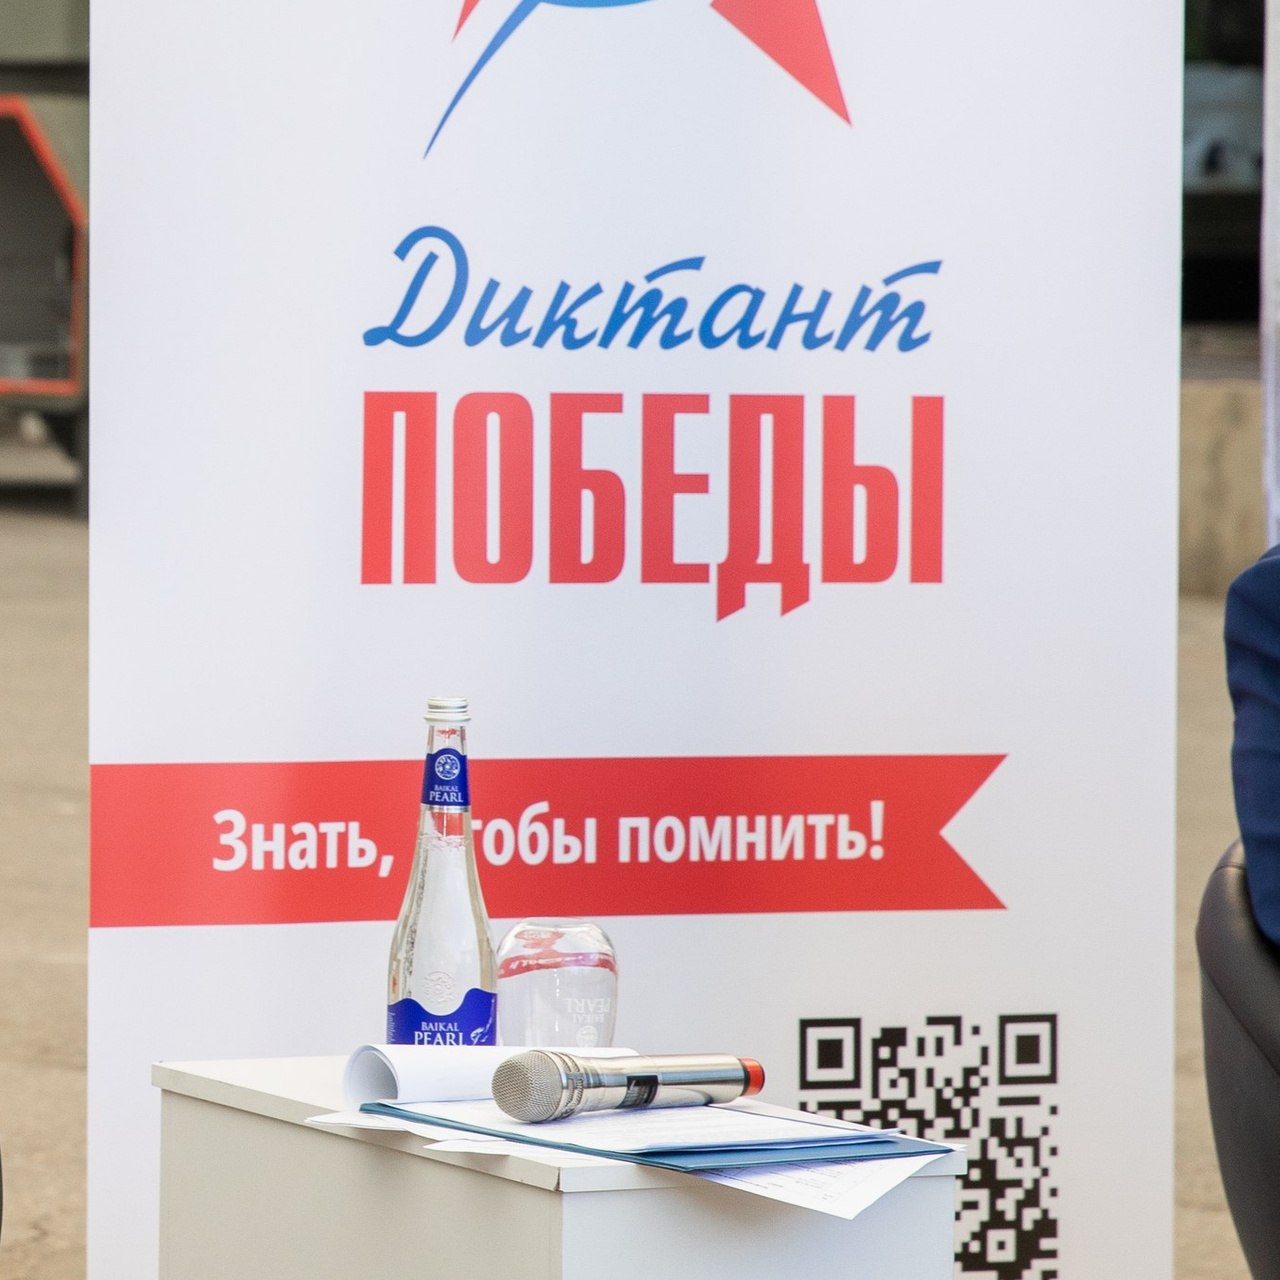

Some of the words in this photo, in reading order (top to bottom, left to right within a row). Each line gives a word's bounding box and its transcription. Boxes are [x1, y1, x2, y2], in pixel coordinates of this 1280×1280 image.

[362, 225, 943, 353] Диктант
[360, 391, 945, 622] ПОБЕДЫ
[429, 790, 464, 803] PEARL
[212, 808, 395, 878] Знать,
[472, 800, 597, 867] обы
[617, 800, 887, 864] помнить!
[414, 1031, 467, 1045] PEARL
[421, 1021, 460, 1032] BAIKAL
